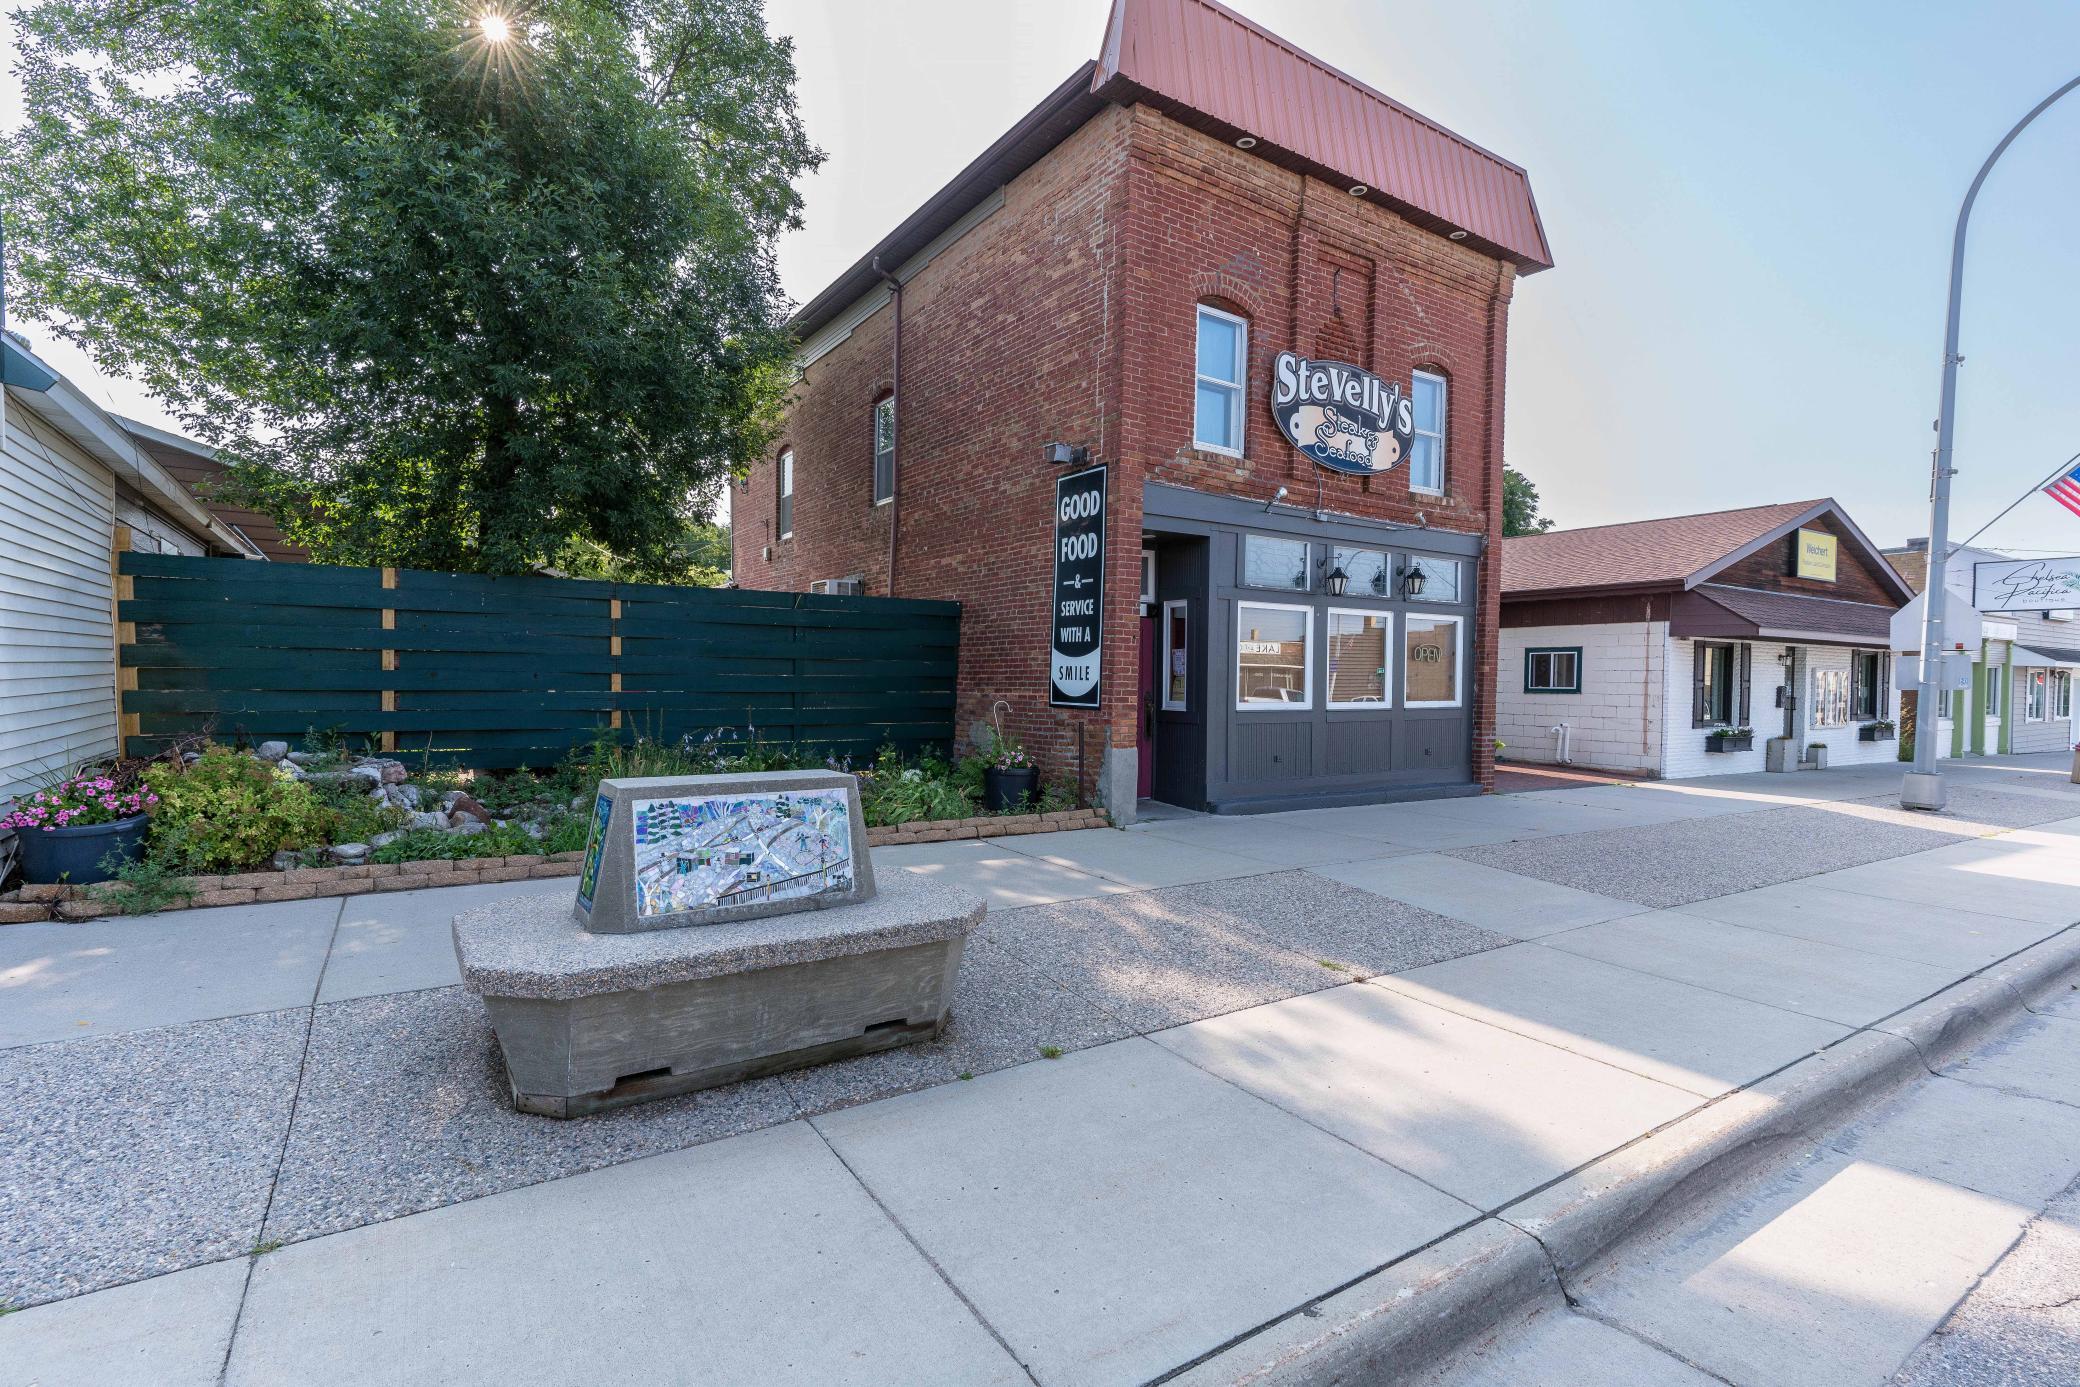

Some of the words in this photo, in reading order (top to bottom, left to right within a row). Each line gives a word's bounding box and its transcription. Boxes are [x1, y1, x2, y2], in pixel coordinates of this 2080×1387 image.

[1315, 425, 1373, 466] Seafood
[1060, 490, 1100, 522] GOOD
[1061, 532, 1098, 562] FOOD
[1074, 573, 1082, 589] &
[2002, 561, 2071, 585] Chelsea
[1992, 576, 2072, 609] Pacifica
[1060, 599, 1094, 617] SERVICE
[1060, 627, 1083, 643] WITH
[1084, 626, 1091, 642] A
[1414, 646, 1442, 663] OPEN
[1059, 665, 1090, 681] SMILE
